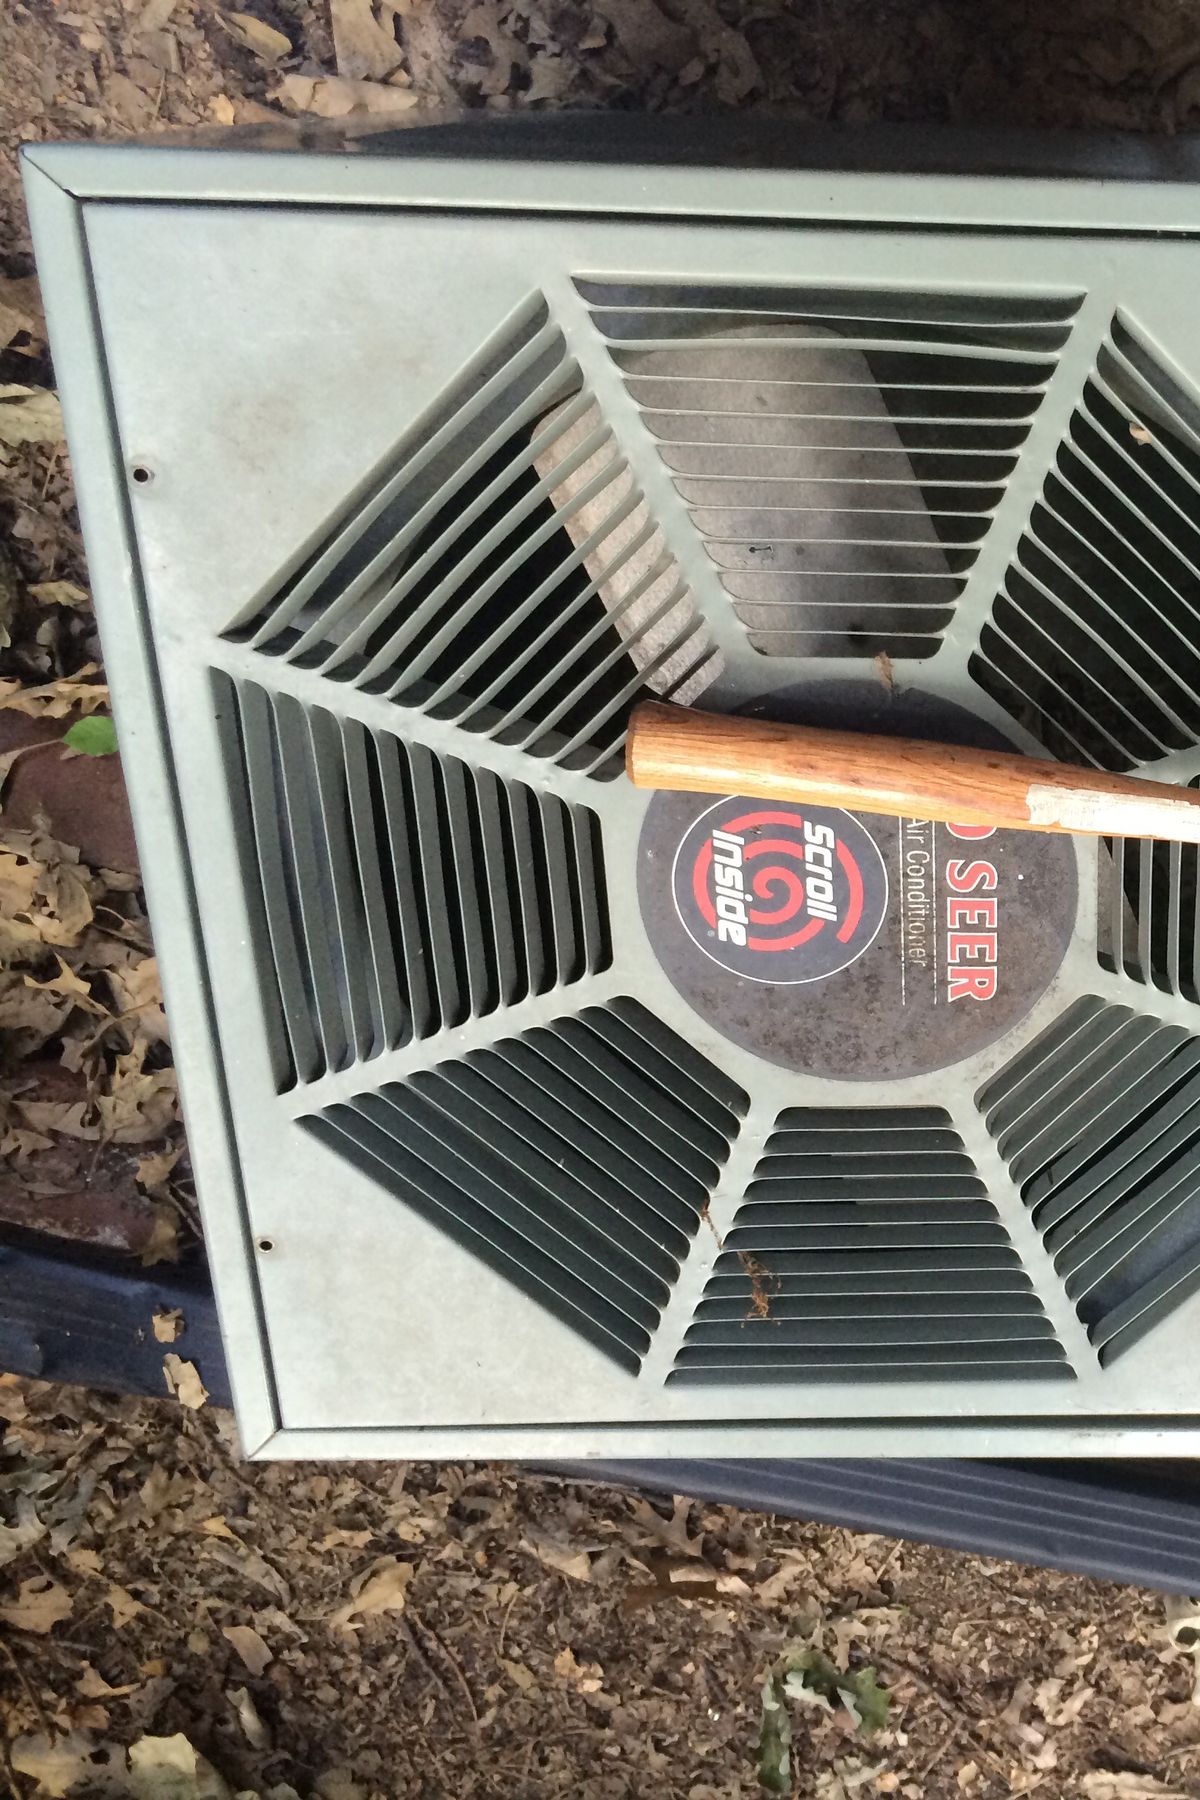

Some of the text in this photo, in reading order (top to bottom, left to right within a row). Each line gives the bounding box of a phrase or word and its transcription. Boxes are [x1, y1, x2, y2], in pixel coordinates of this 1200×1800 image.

[712, 829, 752, 947] Inside
[802, 820, 838, 921] Scroll
[906, 814, 929, 967] Air Conditioner
[946, 860, 998, 1002] SEER
